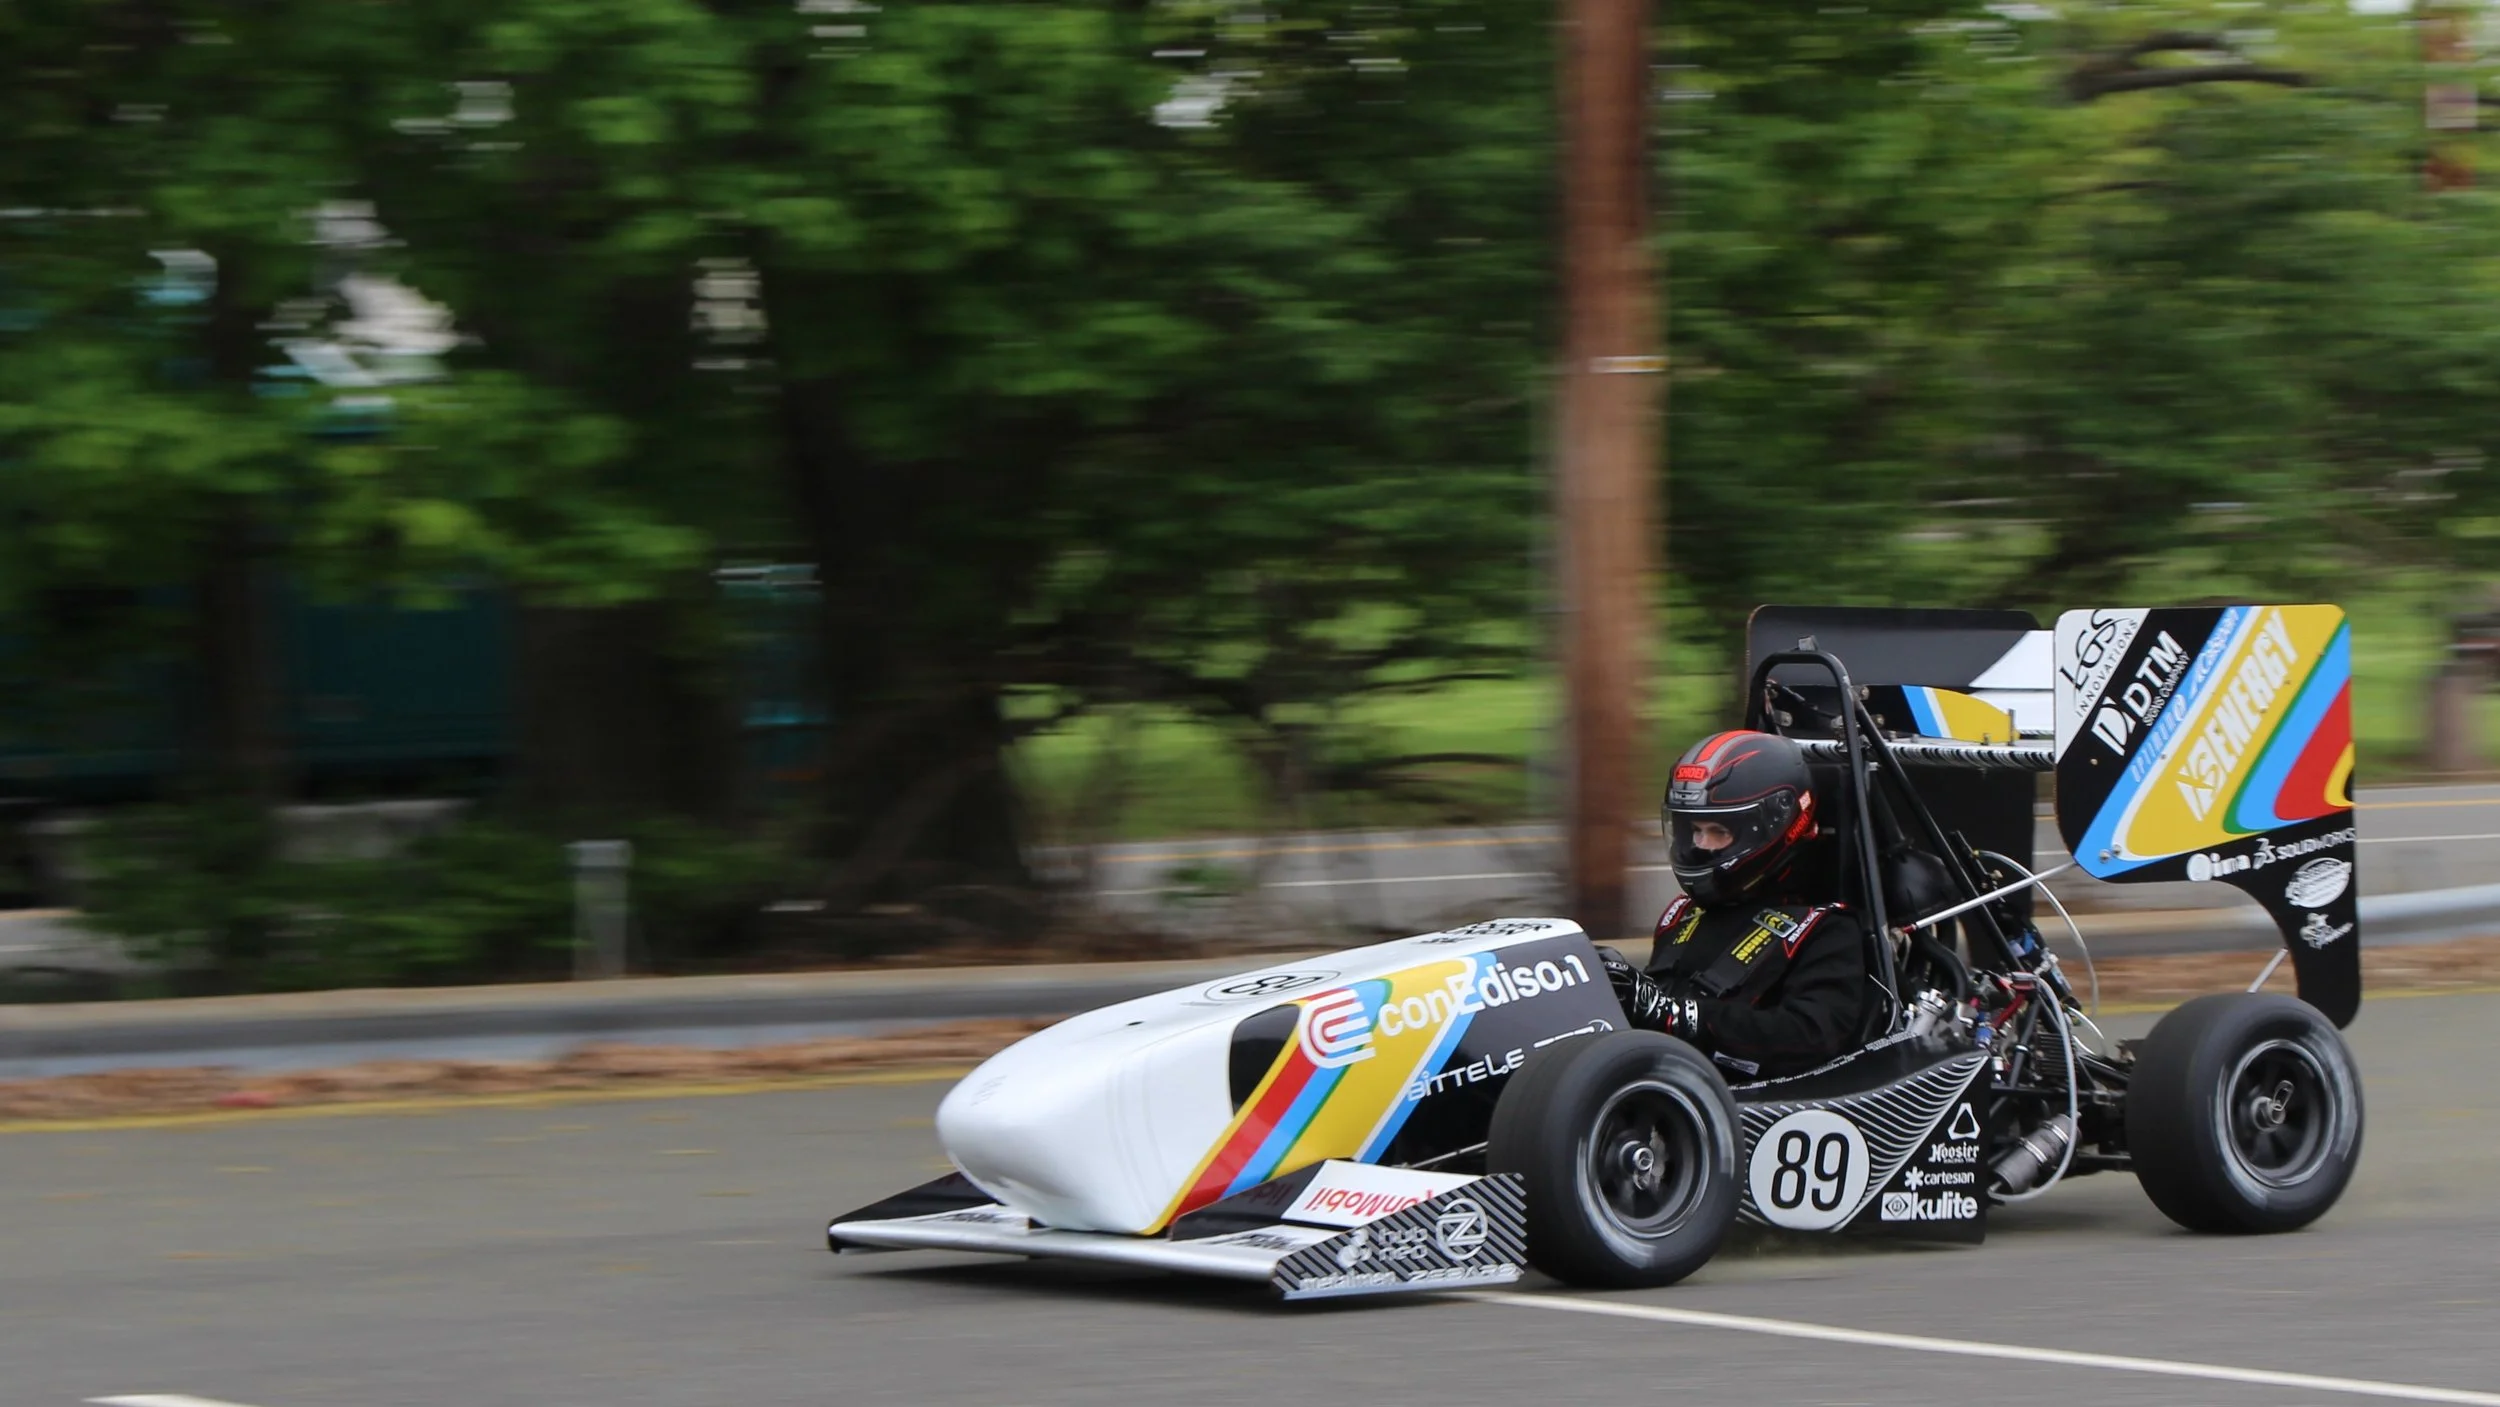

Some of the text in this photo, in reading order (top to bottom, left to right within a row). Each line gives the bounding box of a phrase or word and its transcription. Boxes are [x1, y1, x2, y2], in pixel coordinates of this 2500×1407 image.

[2060, 609, 2116, 691] LGS
[2076, 619, 2138, 719] INNOVATIONS
[2122, 630, 2183, 718] DTM
[1378, 954, 1590, 1036] conEdison
[1771, 1129, 1850, 1212] 89
[1924, 1171, 1975, 1185] cartesian
[1928, 1141, 1980, 1163] Hoosier
[1911, 1191, 1979, 1220] kulite
